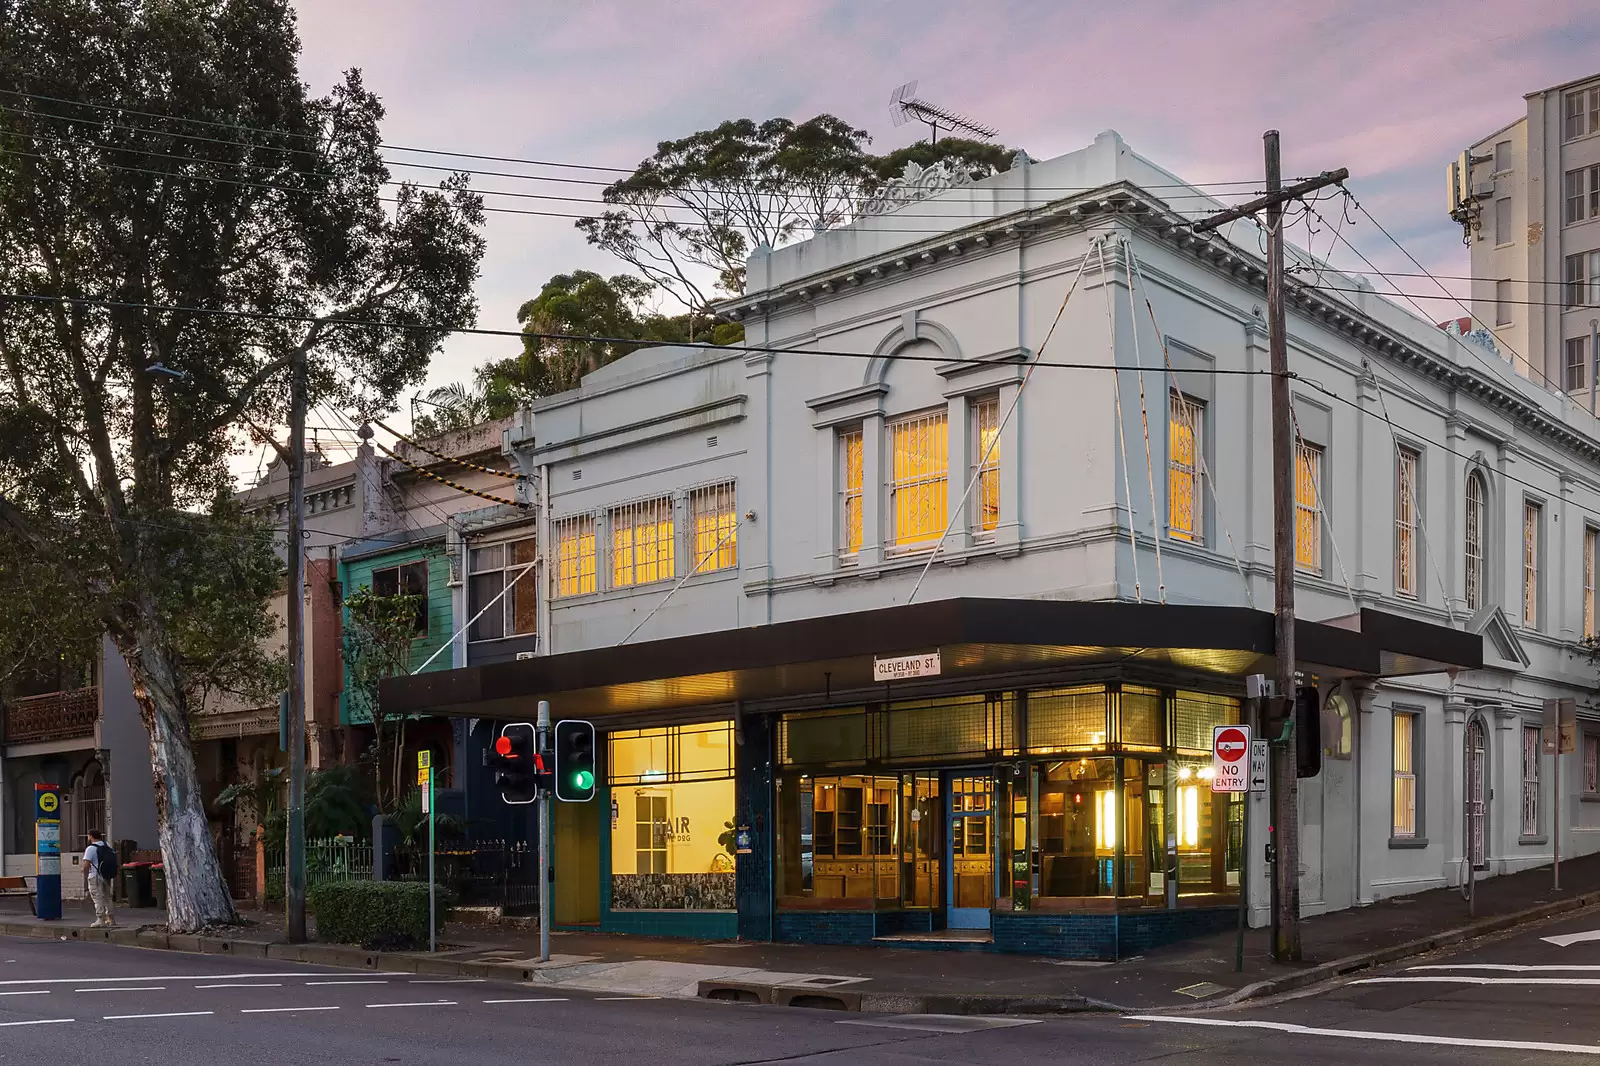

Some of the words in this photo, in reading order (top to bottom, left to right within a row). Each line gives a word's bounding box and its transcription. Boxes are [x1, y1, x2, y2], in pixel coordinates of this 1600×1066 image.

[879, 660, 920, 673] CLEVELAND
[925, 658, 935, 669] ST.
[1253, 744, 1265, 757] ONE
[1222, 765, 1238, 775] NO
[1253, 761, 1265, 772] WAY
[1216, 778, 1244, 787] ENTRY
[653, 817, 690, 835] HAIR
[677, 834, 691, 842] DOG
